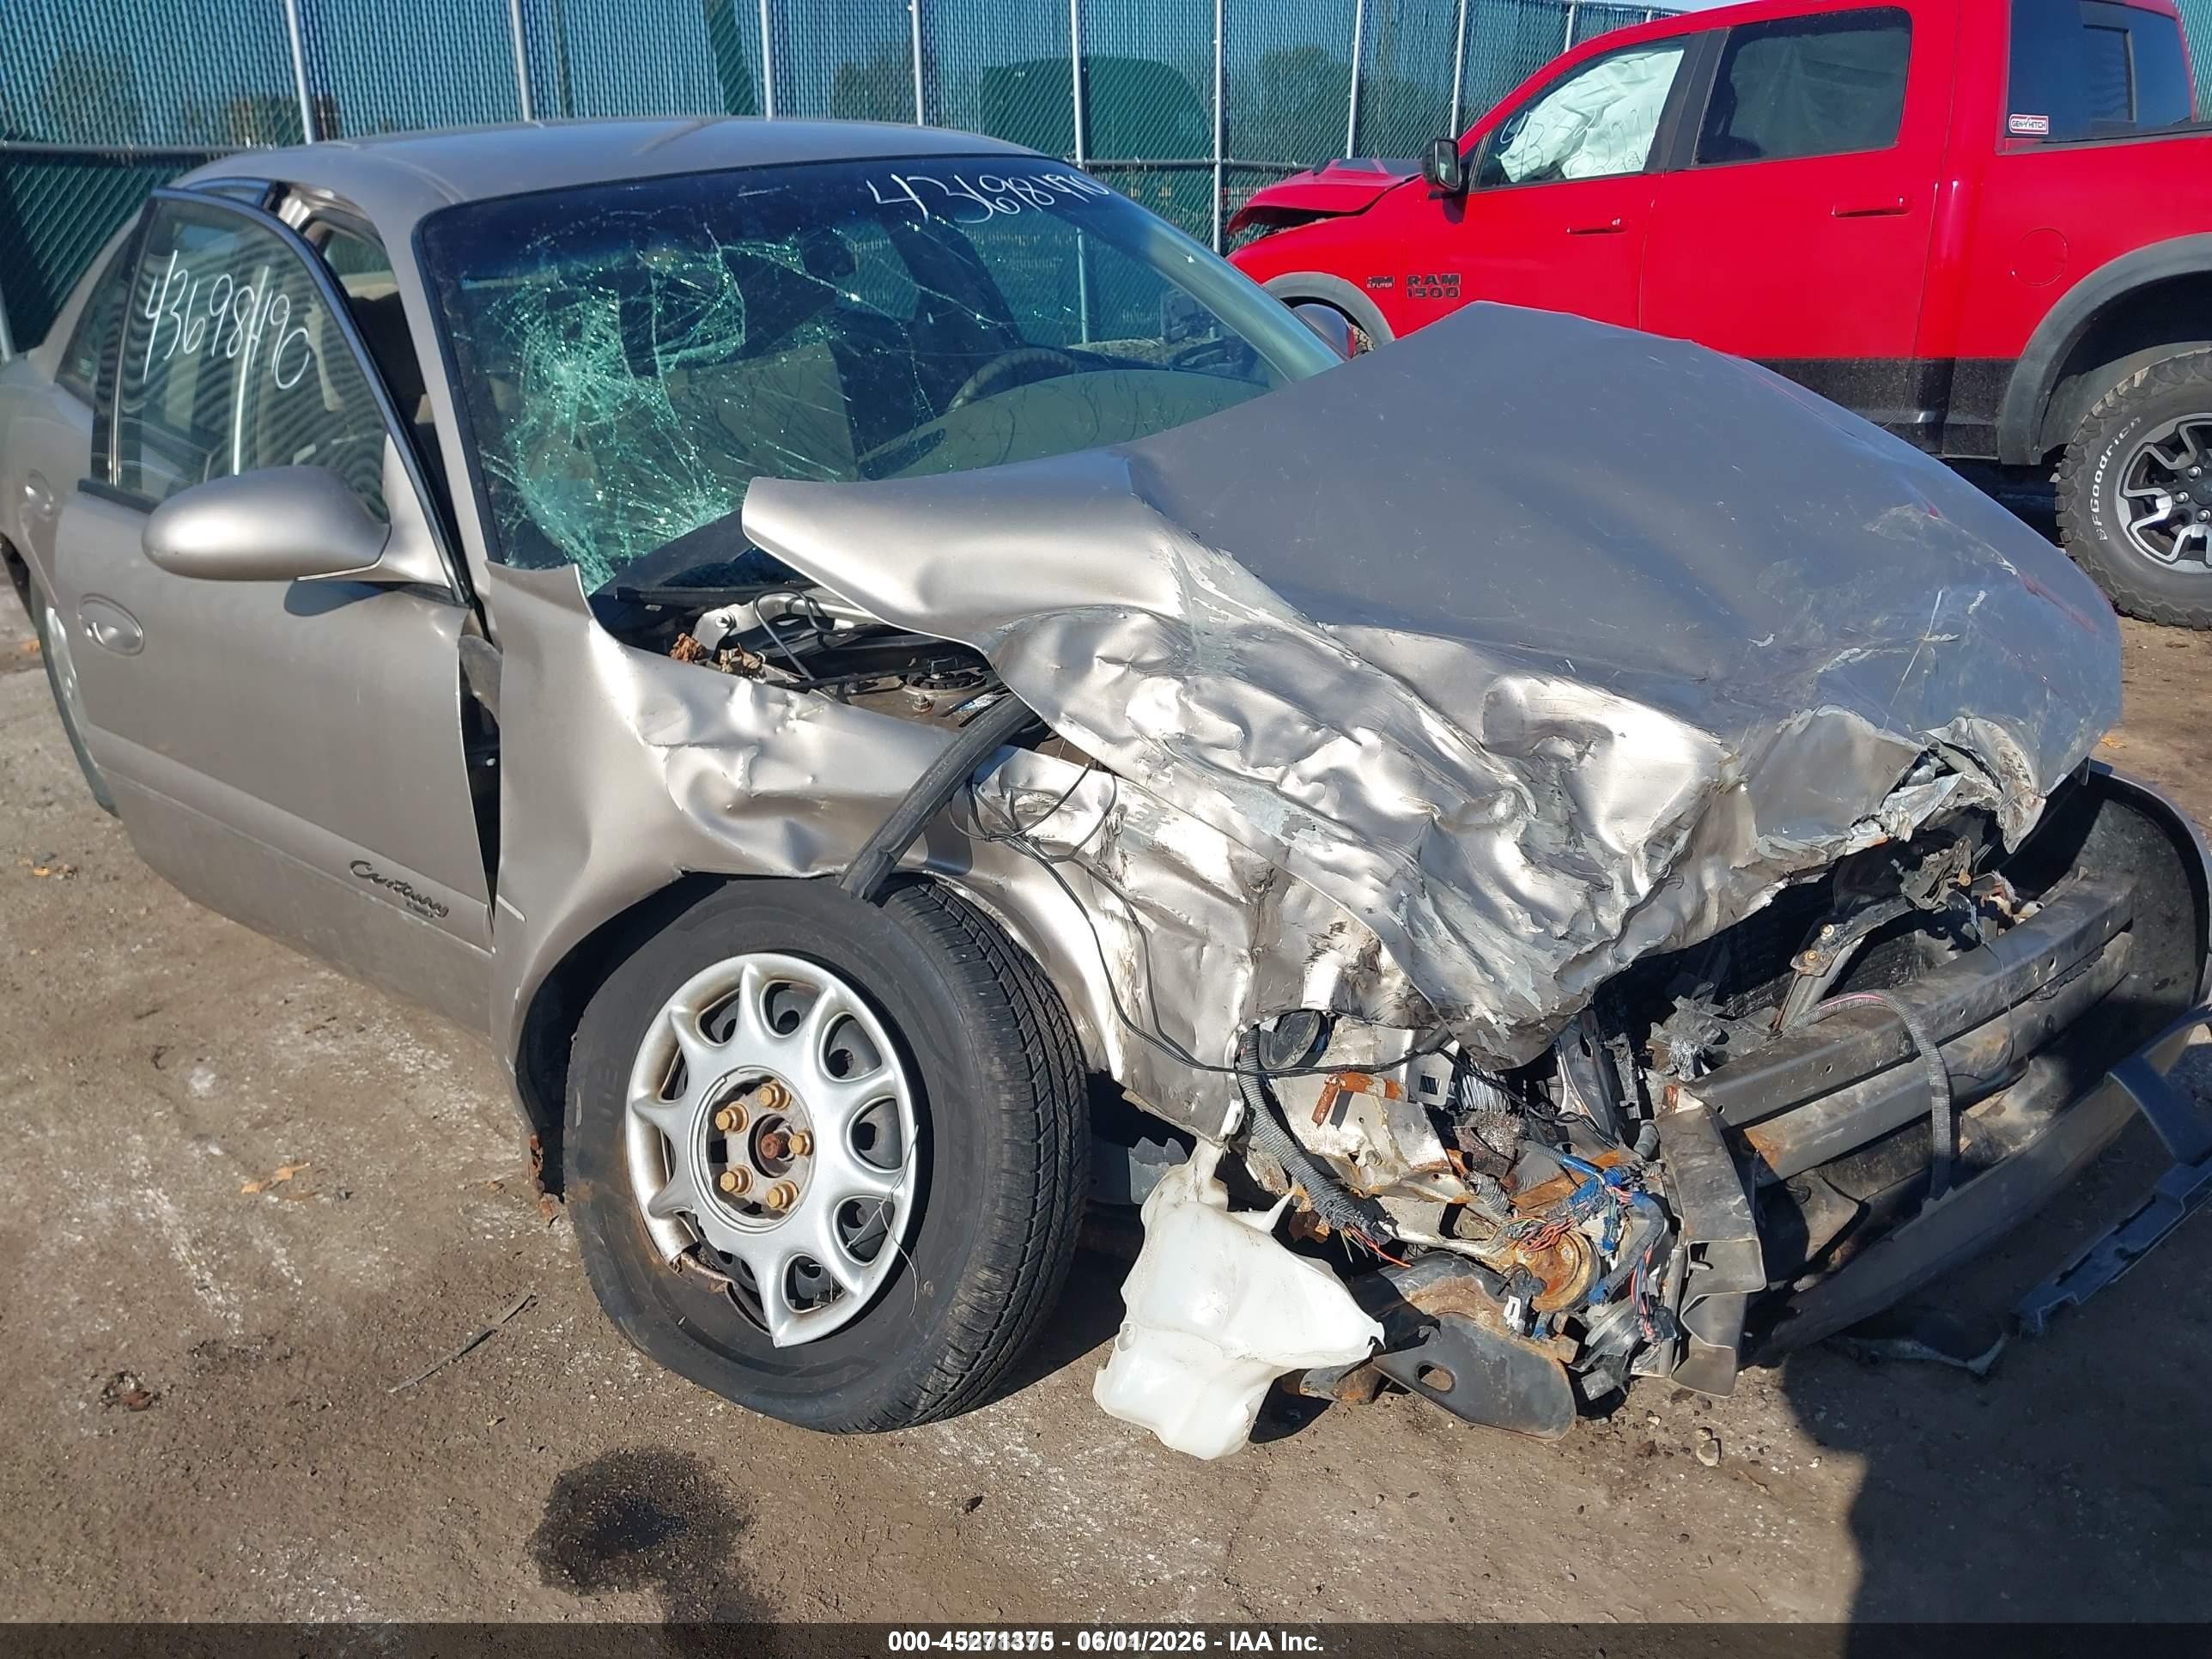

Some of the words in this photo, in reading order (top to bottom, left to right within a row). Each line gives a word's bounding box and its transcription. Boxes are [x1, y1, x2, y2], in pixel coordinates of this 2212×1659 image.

[1407, 274, 1461, 285] RAM
[1407, 286, 1461, 299] 1500
[349, 860, 449, 918] Century
